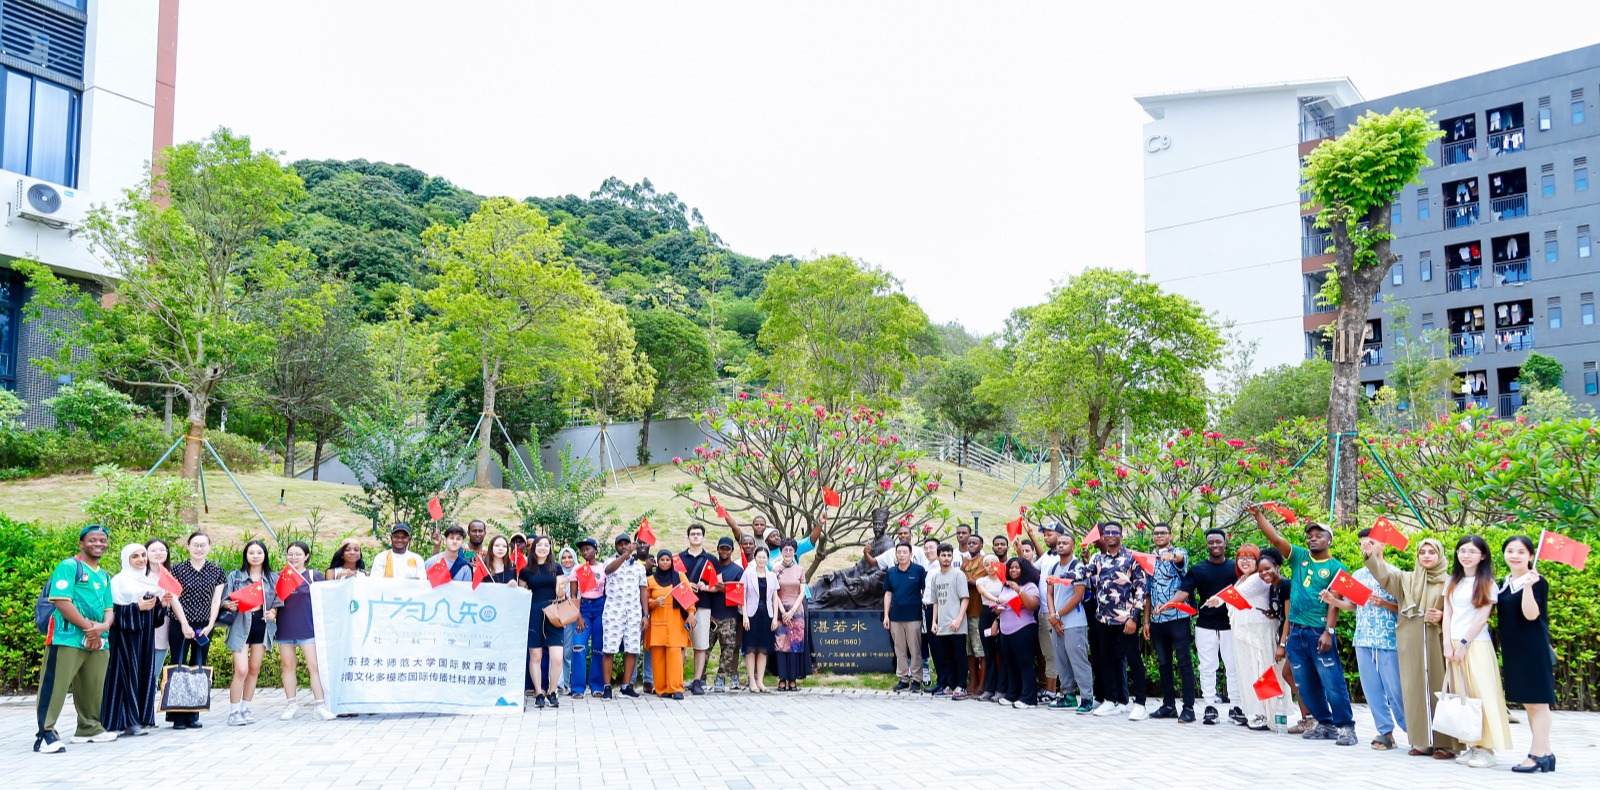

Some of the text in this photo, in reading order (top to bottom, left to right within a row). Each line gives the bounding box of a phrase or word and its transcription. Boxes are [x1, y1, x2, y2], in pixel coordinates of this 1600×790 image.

[813, 620, 868, 633] 湛若水
[344, 656, 507, 672] 东技术师范大学国际教育学院
